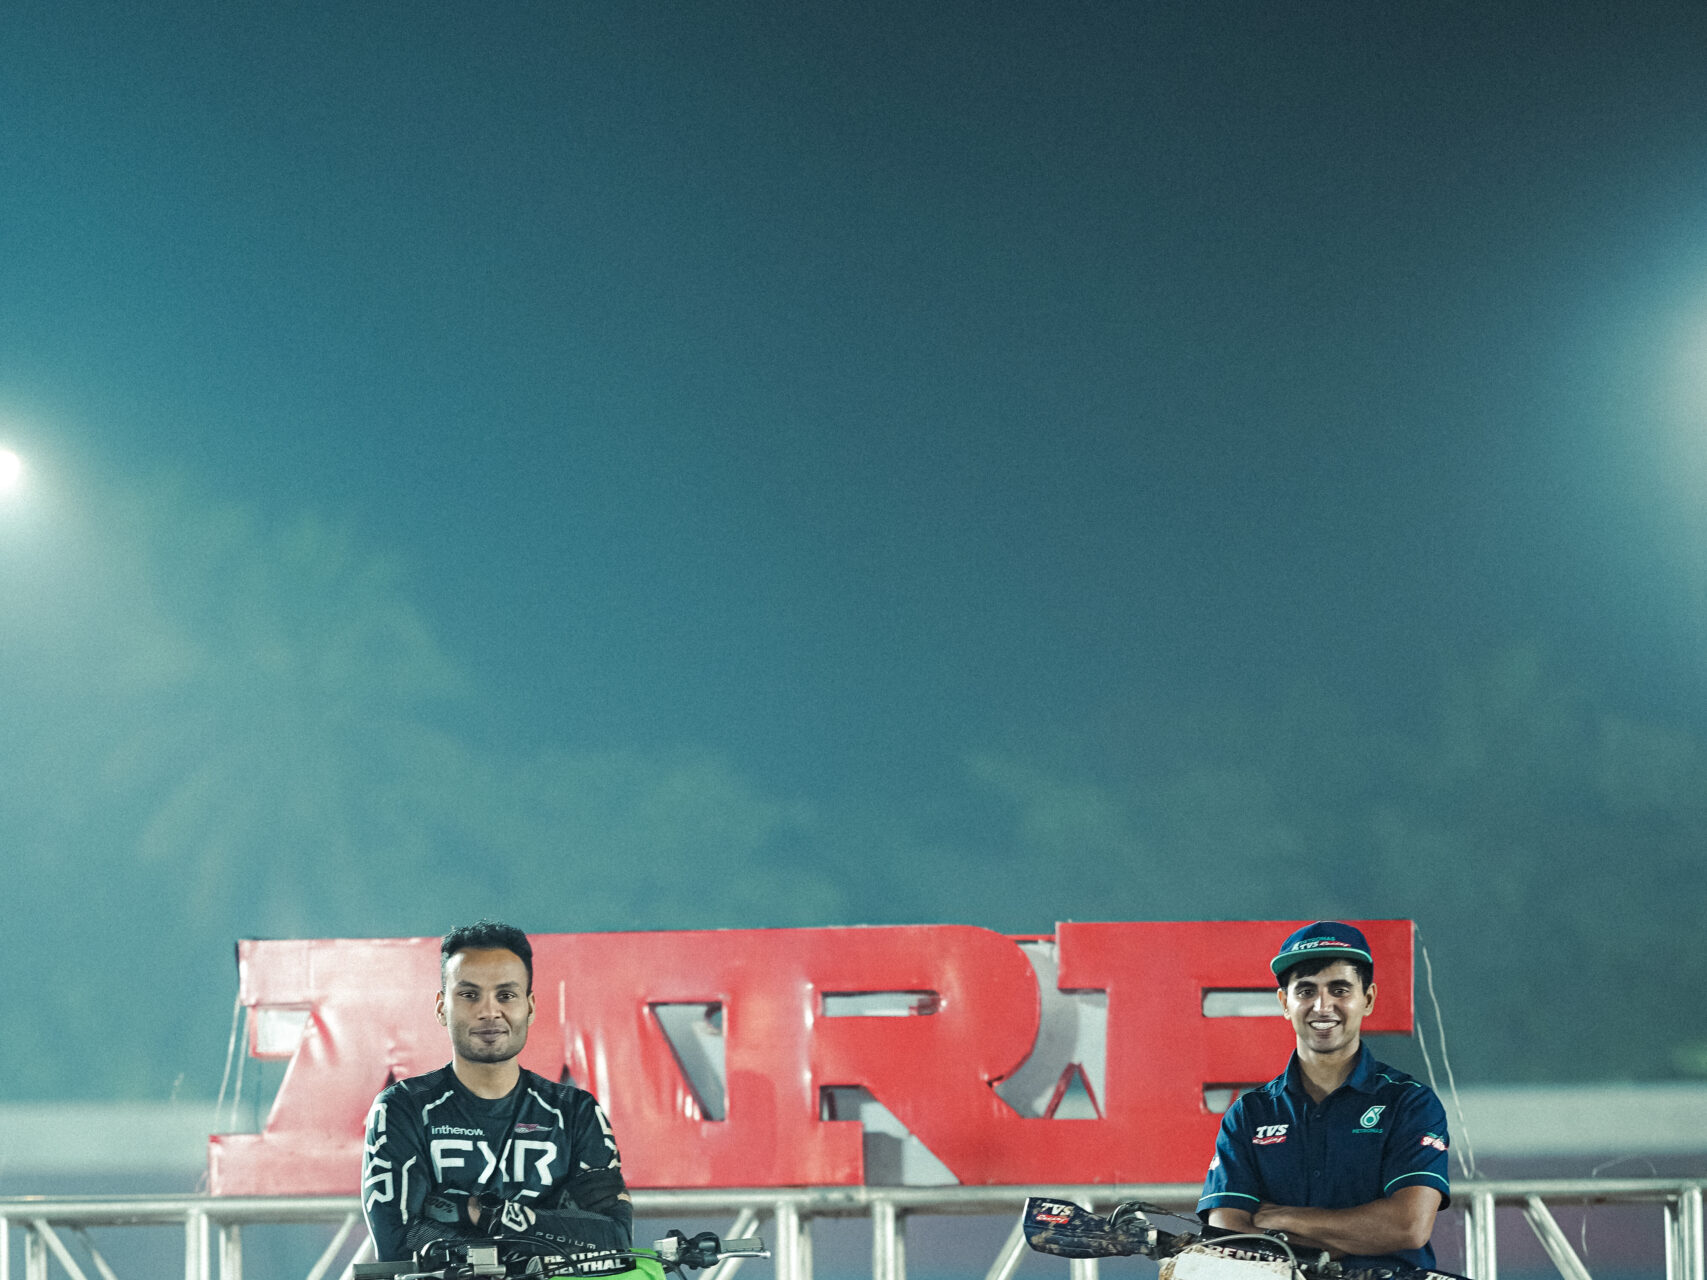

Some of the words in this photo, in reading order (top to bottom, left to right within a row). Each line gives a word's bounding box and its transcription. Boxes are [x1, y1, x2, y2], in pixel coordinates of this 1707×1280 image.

[1256, 1124, 1289, 1138] TVS
[430, 1139, 557, 1186] FXR
[1041, 1202, 1075, 1216] TVS
[535, 1231, 596, 1250] PODIUM
